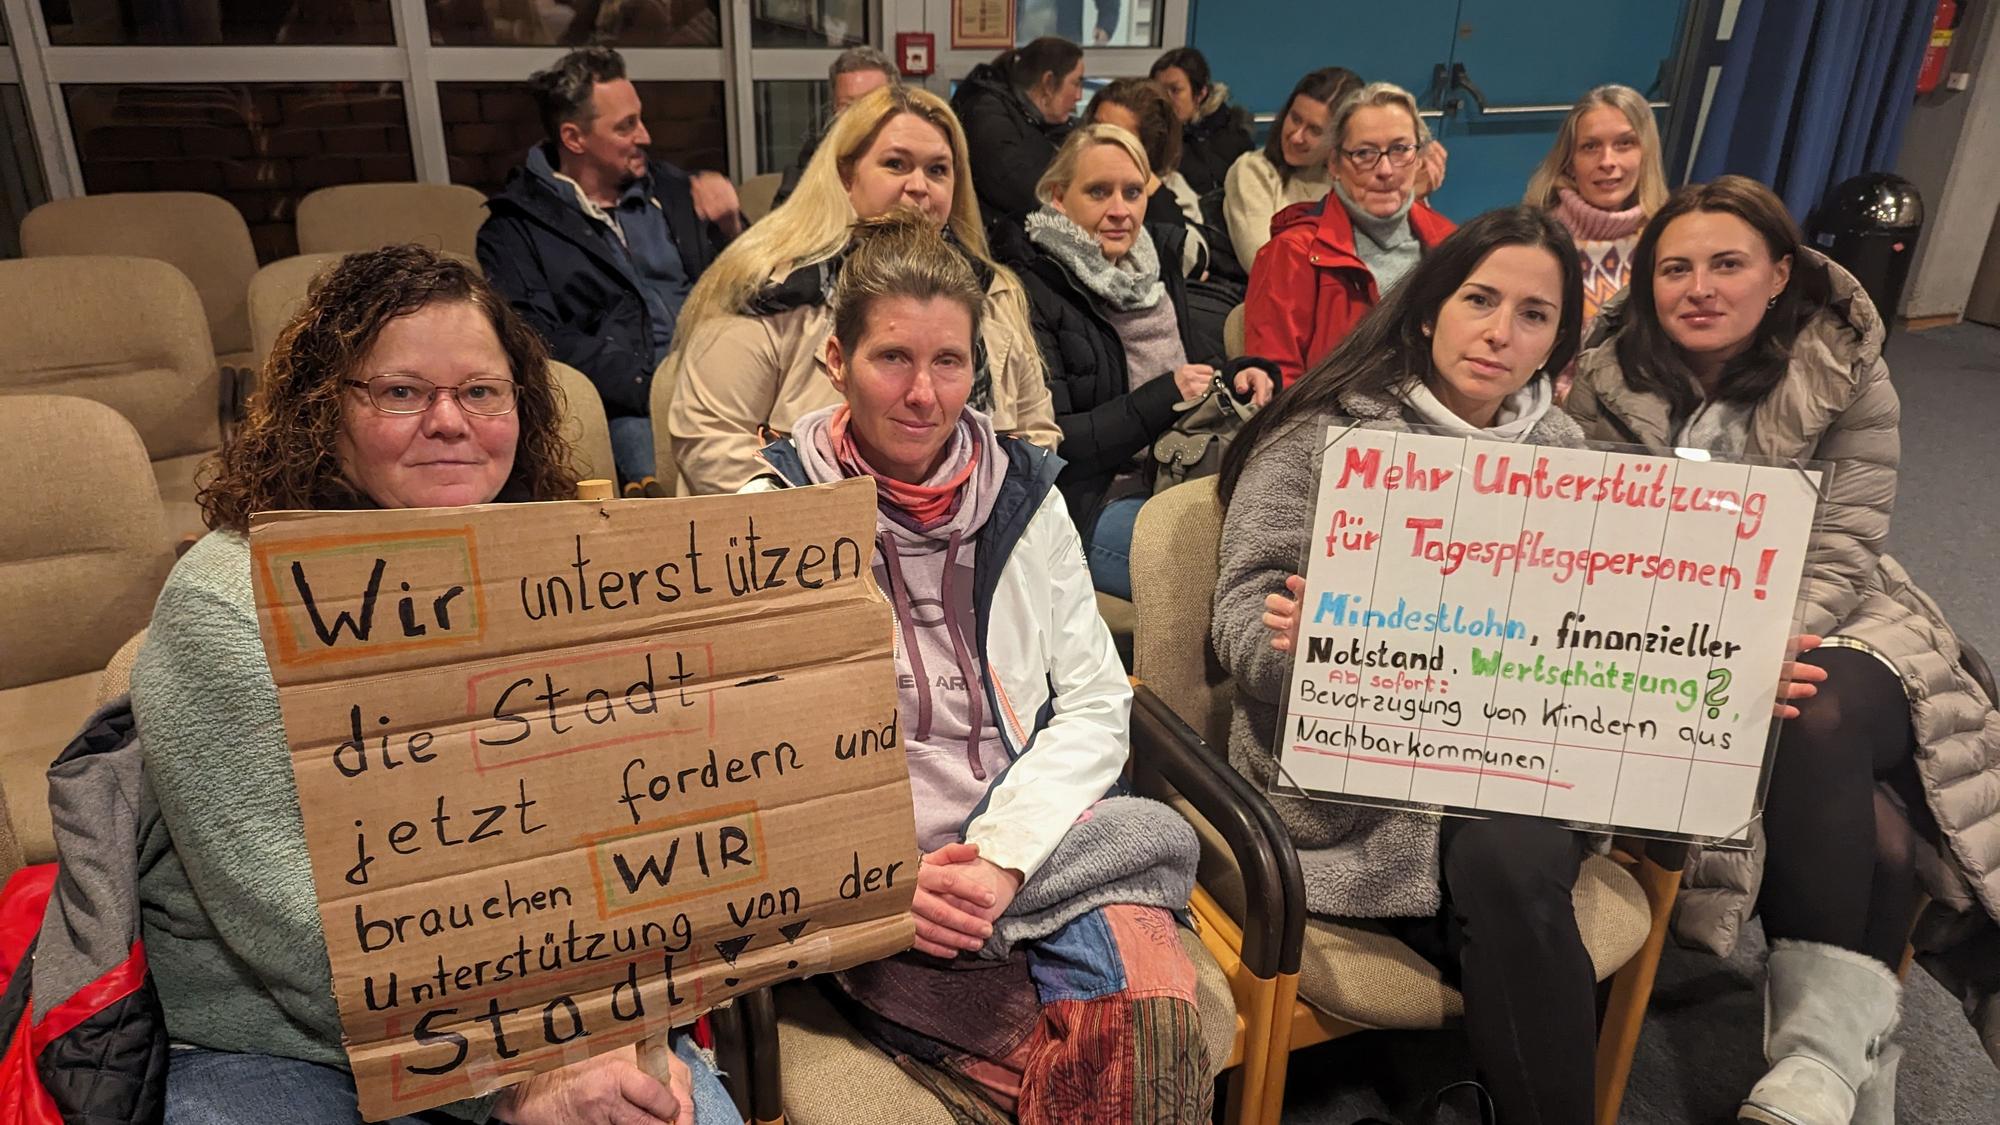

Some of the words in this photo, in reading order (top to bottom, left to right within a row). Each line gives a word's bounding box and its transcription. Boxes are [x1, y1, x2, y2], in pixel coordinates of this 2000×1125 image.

[1326, 509, 1381, 557] für
[1336, 447, 1453, 492] Mehr
[1473, 453, 1767, 540] Unterstützung
[292, 558, 464, 646] Wir
[523, 516, 860, 621] unterstützen
[1328, 669, 1360, 685] Ab
[1556, 611, 1741, 660] finanzieller
[333, 704, 438, 778] die
[478, 652, 695, 746] Stadt
[1301, 680, 1462, 727] Bevorzugung
[1483, 702, 1527, 726] von
[1542, 698, 1657, 740] Kindern
[1679, 726, 1732, 750] aus
[345, 778, 547, 885] jetzt
[618, 741, 804, 825] fordern
[834, 708, 898, 761] und
[354, 880, 571, 953] brauchen
[613, 825, 754, 895] WIR
[728, 886, 801, 928] von
[839, 852, 904, 900] der
